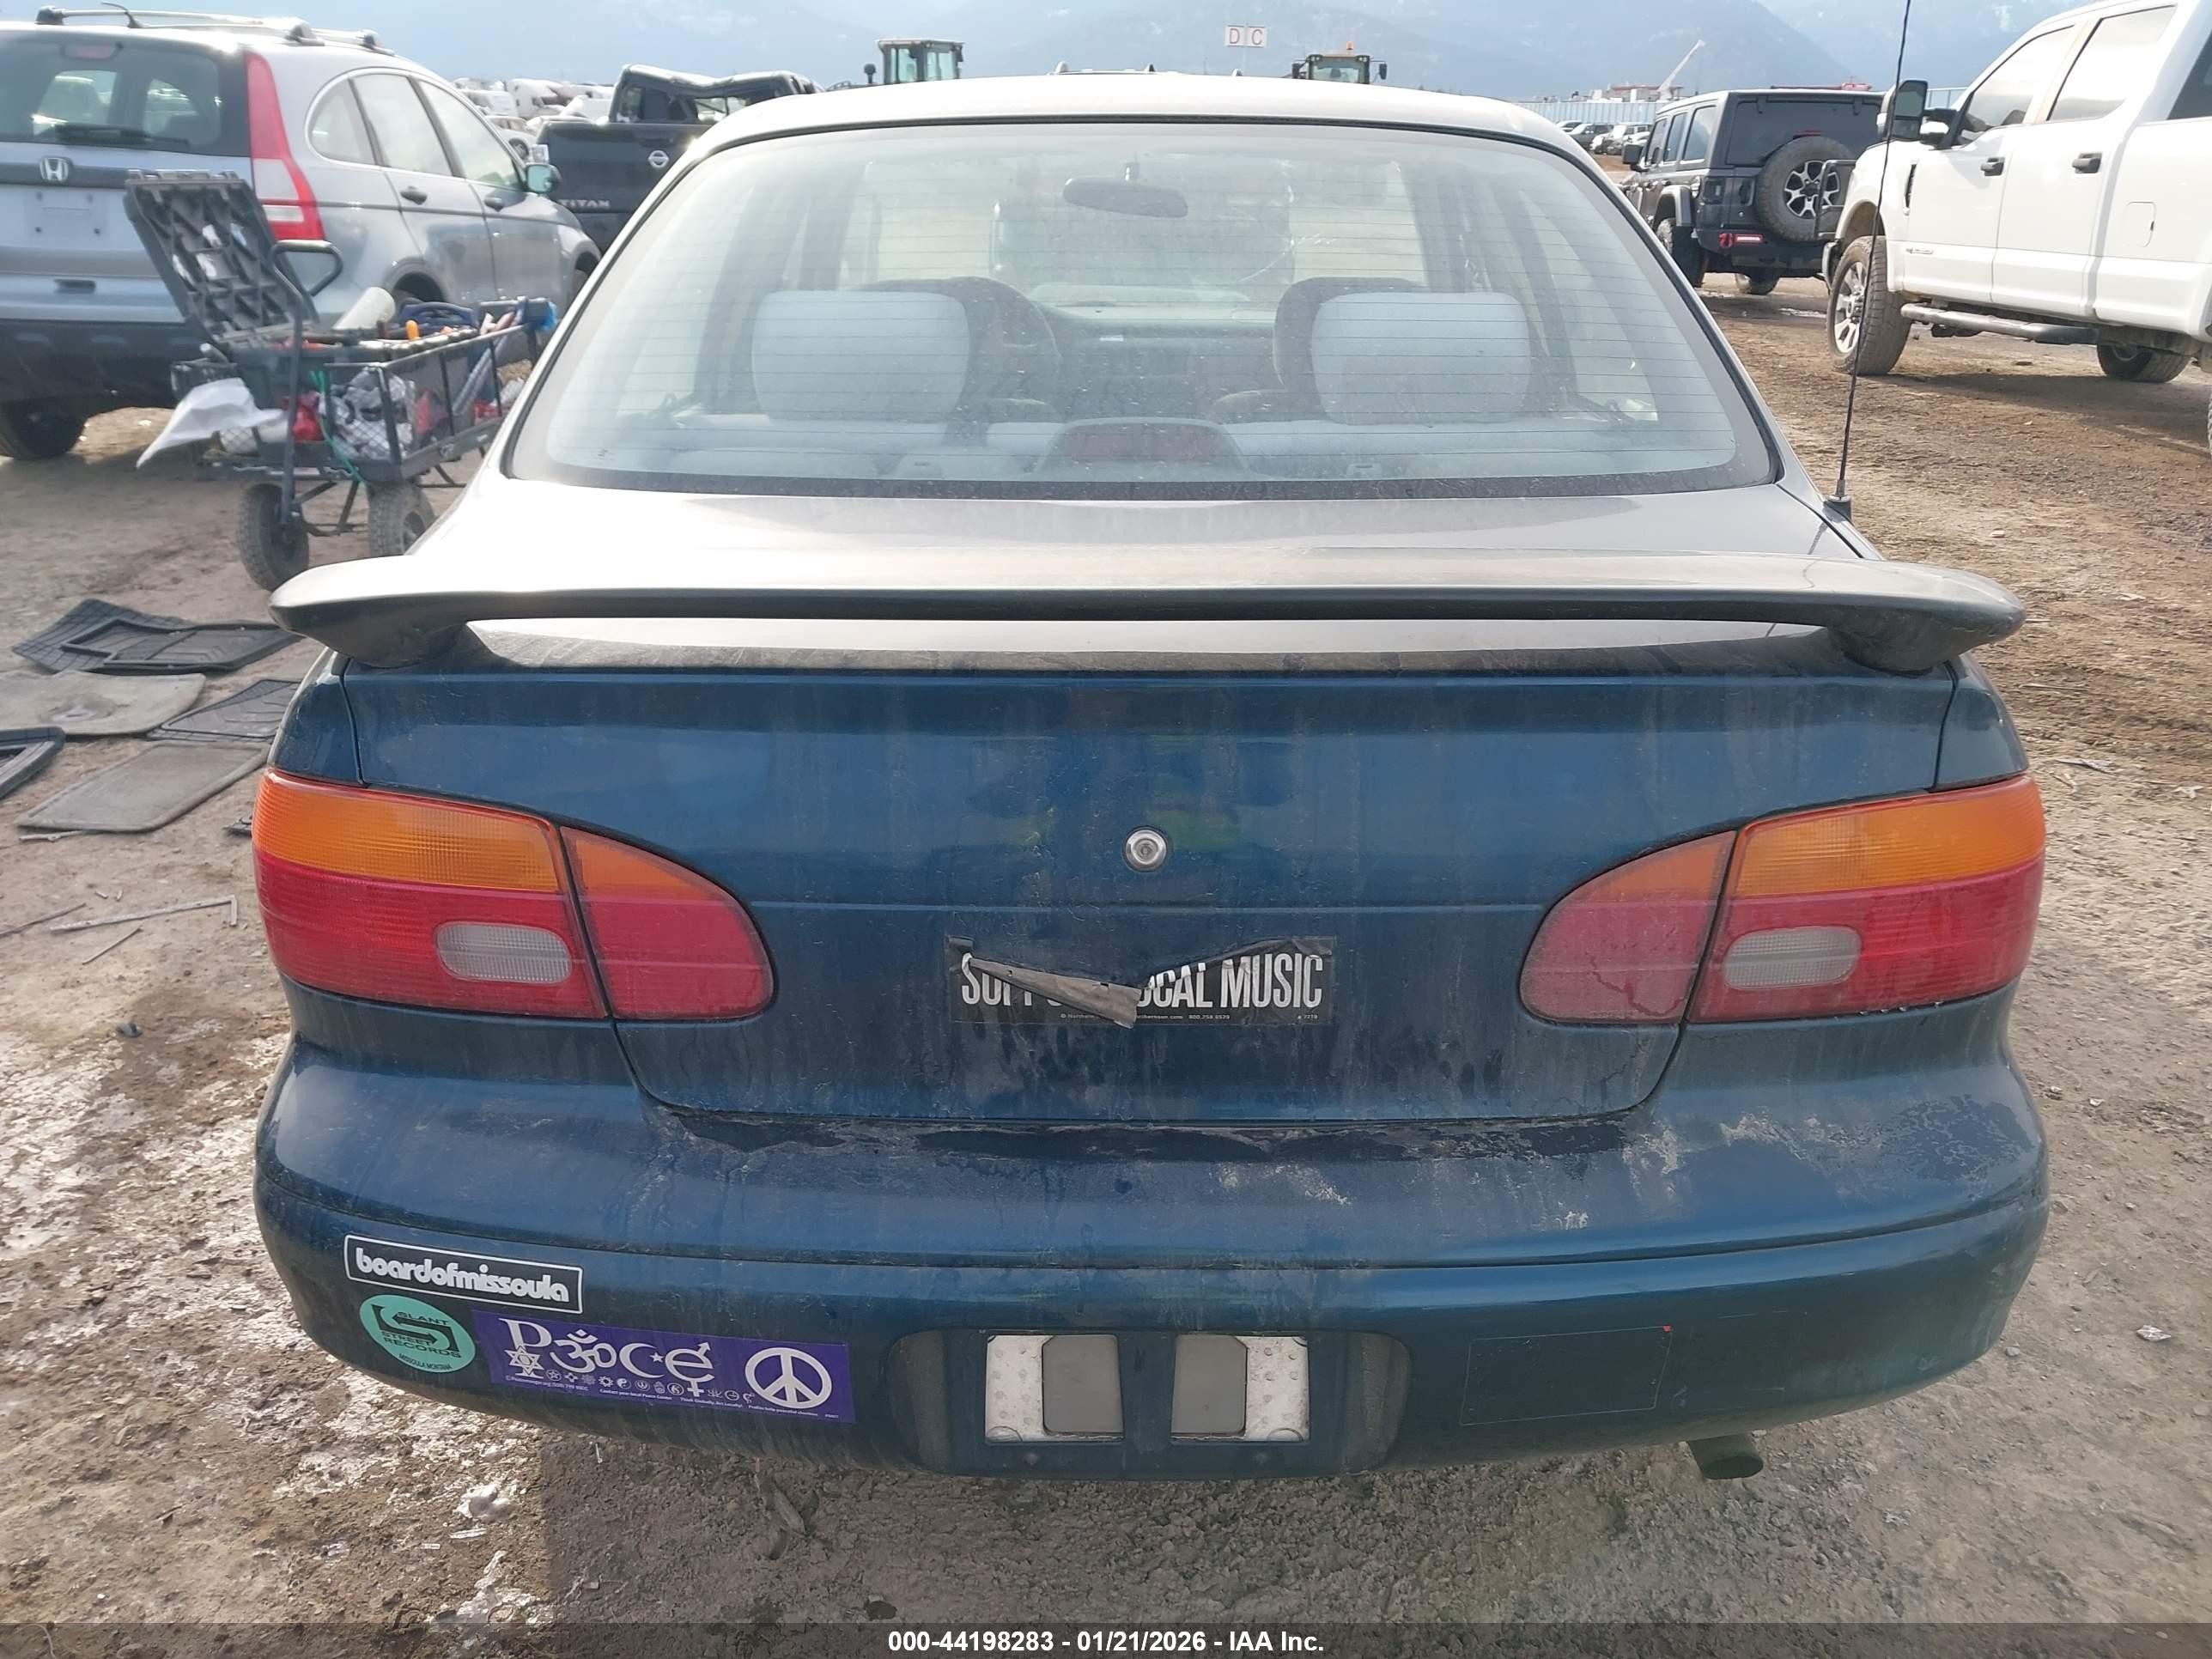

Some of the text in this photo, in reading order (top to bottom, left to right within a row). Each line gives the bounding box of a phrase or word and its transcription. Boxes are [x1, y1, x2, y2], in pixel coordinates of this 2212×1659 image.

[1229, 27, 1263, 46] D C
[558, 198, 611, 208] TITAN
[1220, 952, 1323, 1008] MUSIC
[356, 1247, 570, 1303] boardofmissoula
[397, 1311, 449, 1325] SLANT
[381, 1330, 433, 1346] STREET
[383, 1337, 461, 1358] RECORDS
